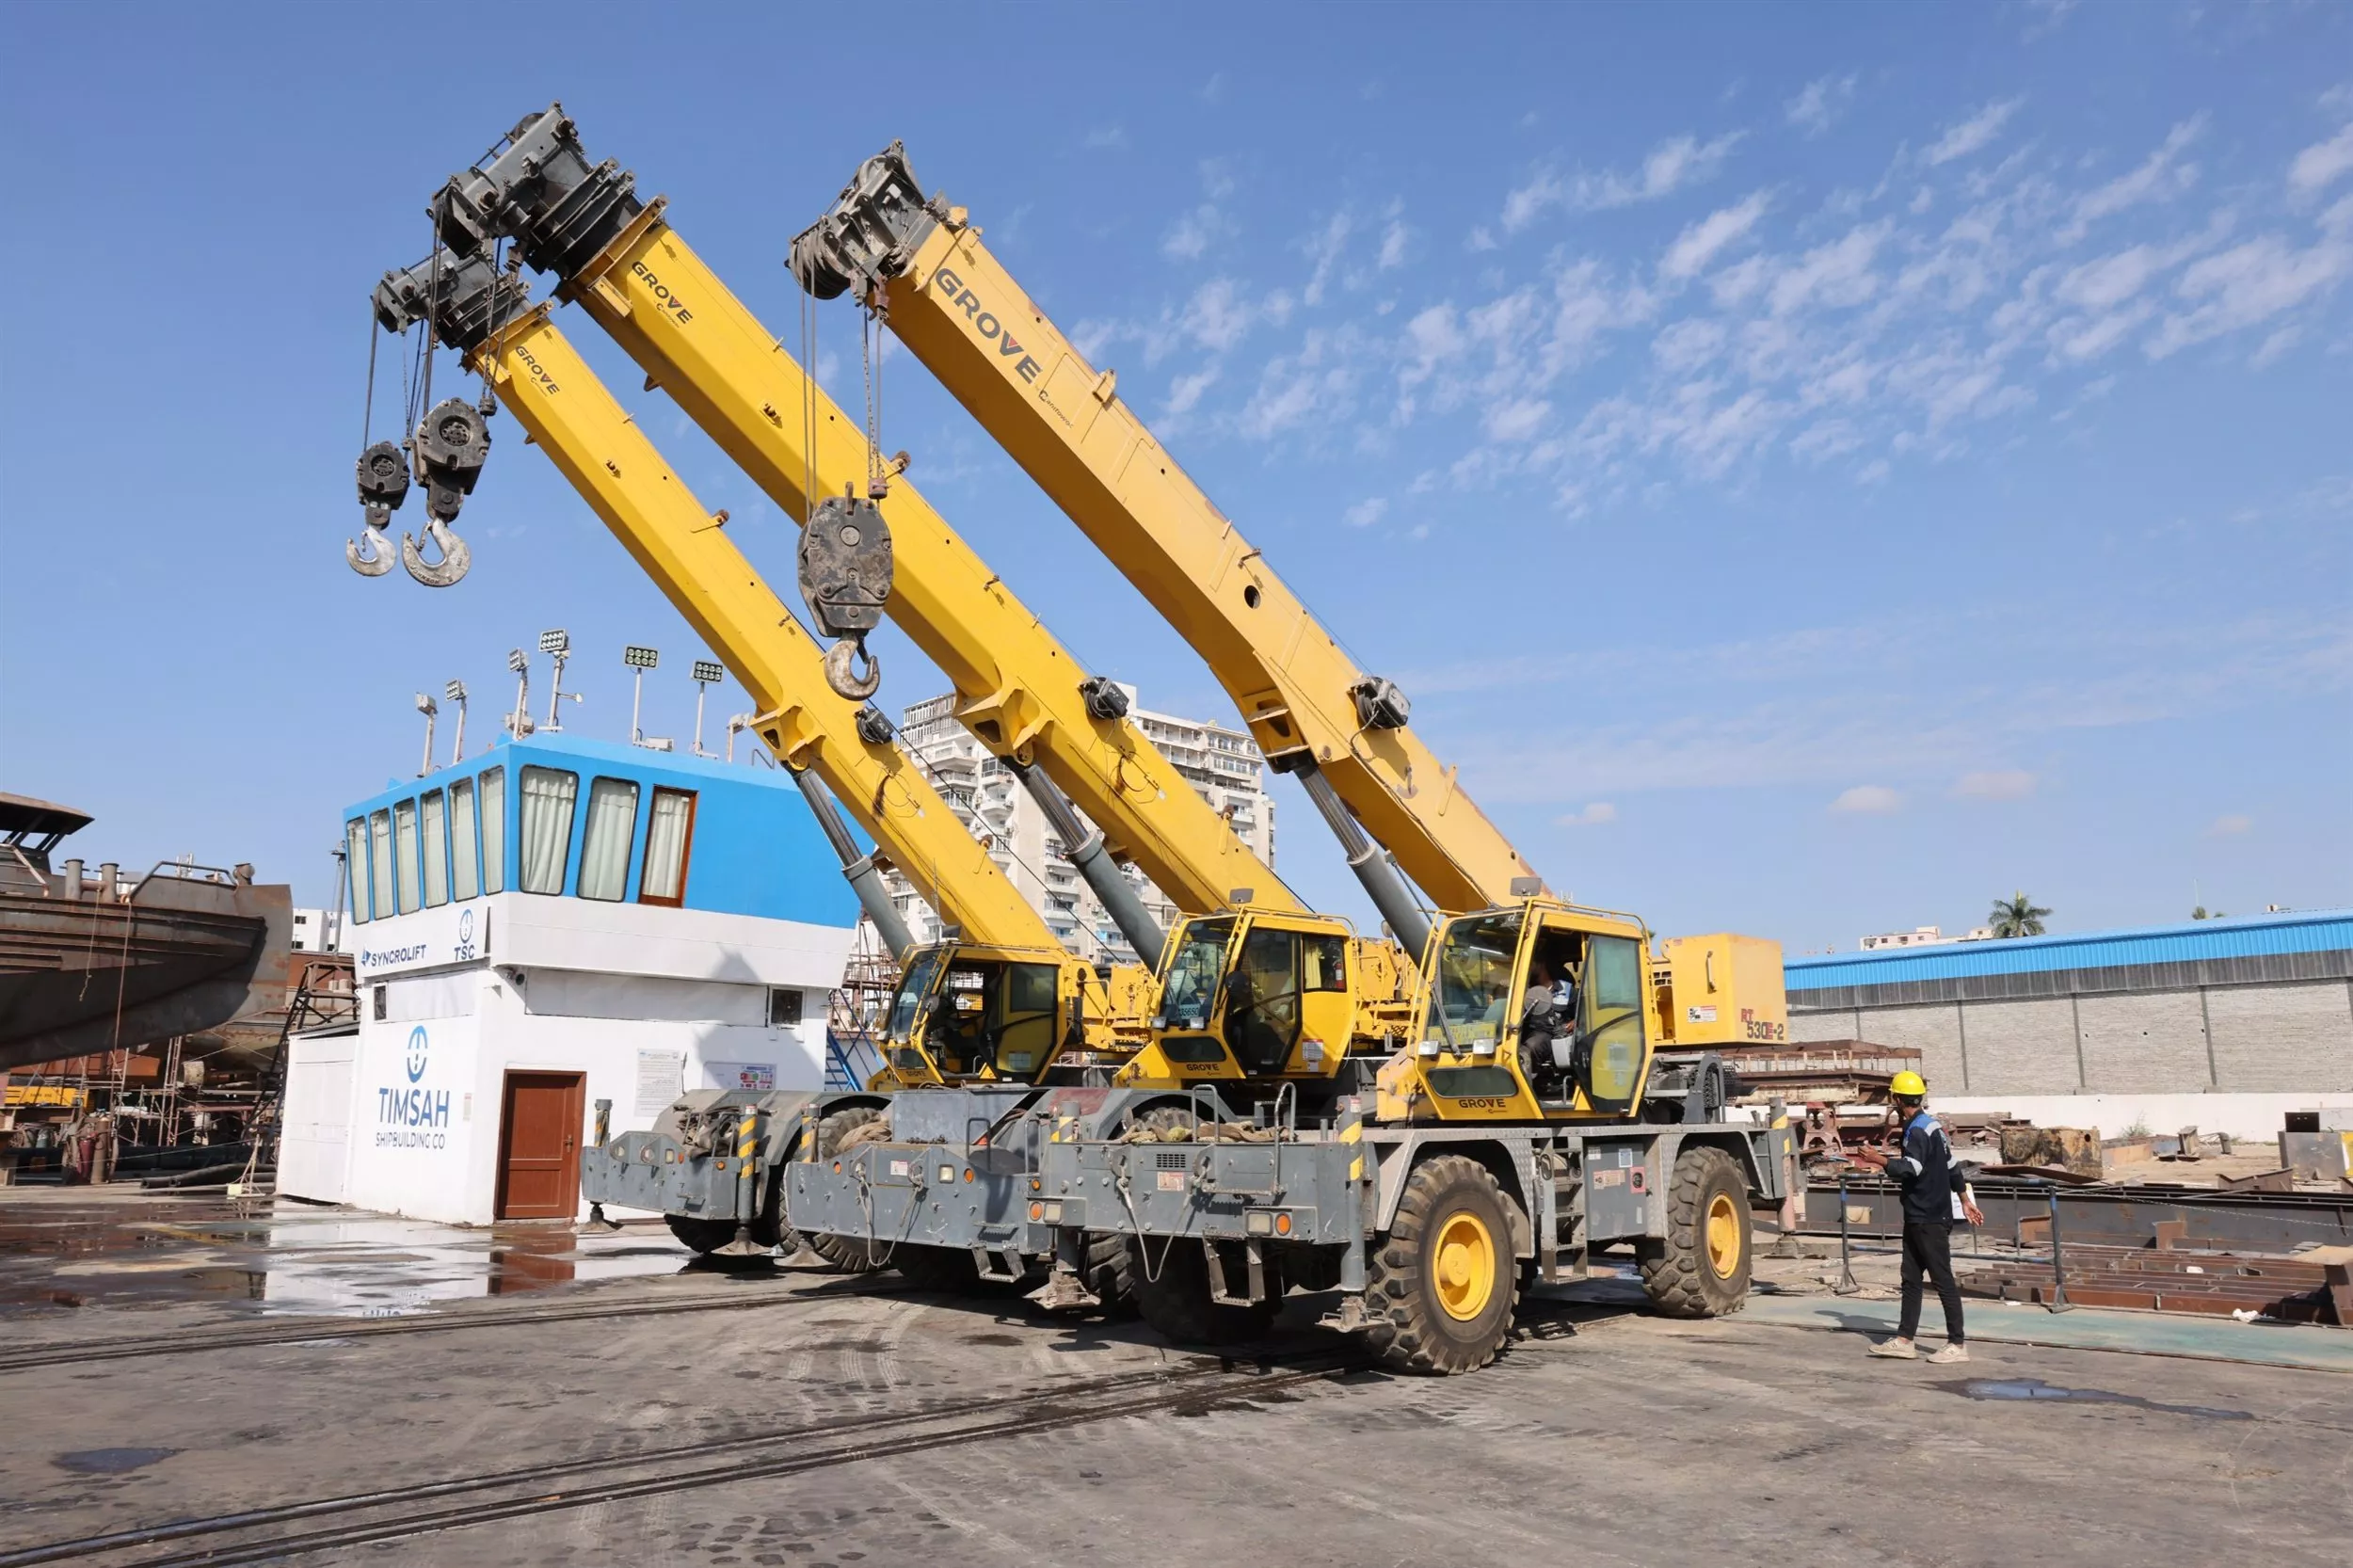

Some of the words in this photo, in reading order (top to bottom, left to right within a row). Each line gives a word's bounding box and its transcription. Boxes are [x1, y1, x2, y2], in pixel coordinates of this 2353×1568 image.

[632, 261, 693, 324] GROVE
[936, 268, 1042, 384] GROVE
[515, 345, 560, 394] GROVE
[372, 944, 426, 967] SYNCROLIFT
[454, 944, 475, 961] TSC
[1740, 1008, 1753, 1022] RT
[378, 1087, 450, 1128] TIMSAH
[1459, 1098, 1506, 1109] GROVE
[376, 1131, 431, 1149] SHIPBUILDING
[432, 1133, 445, 1150] CO
